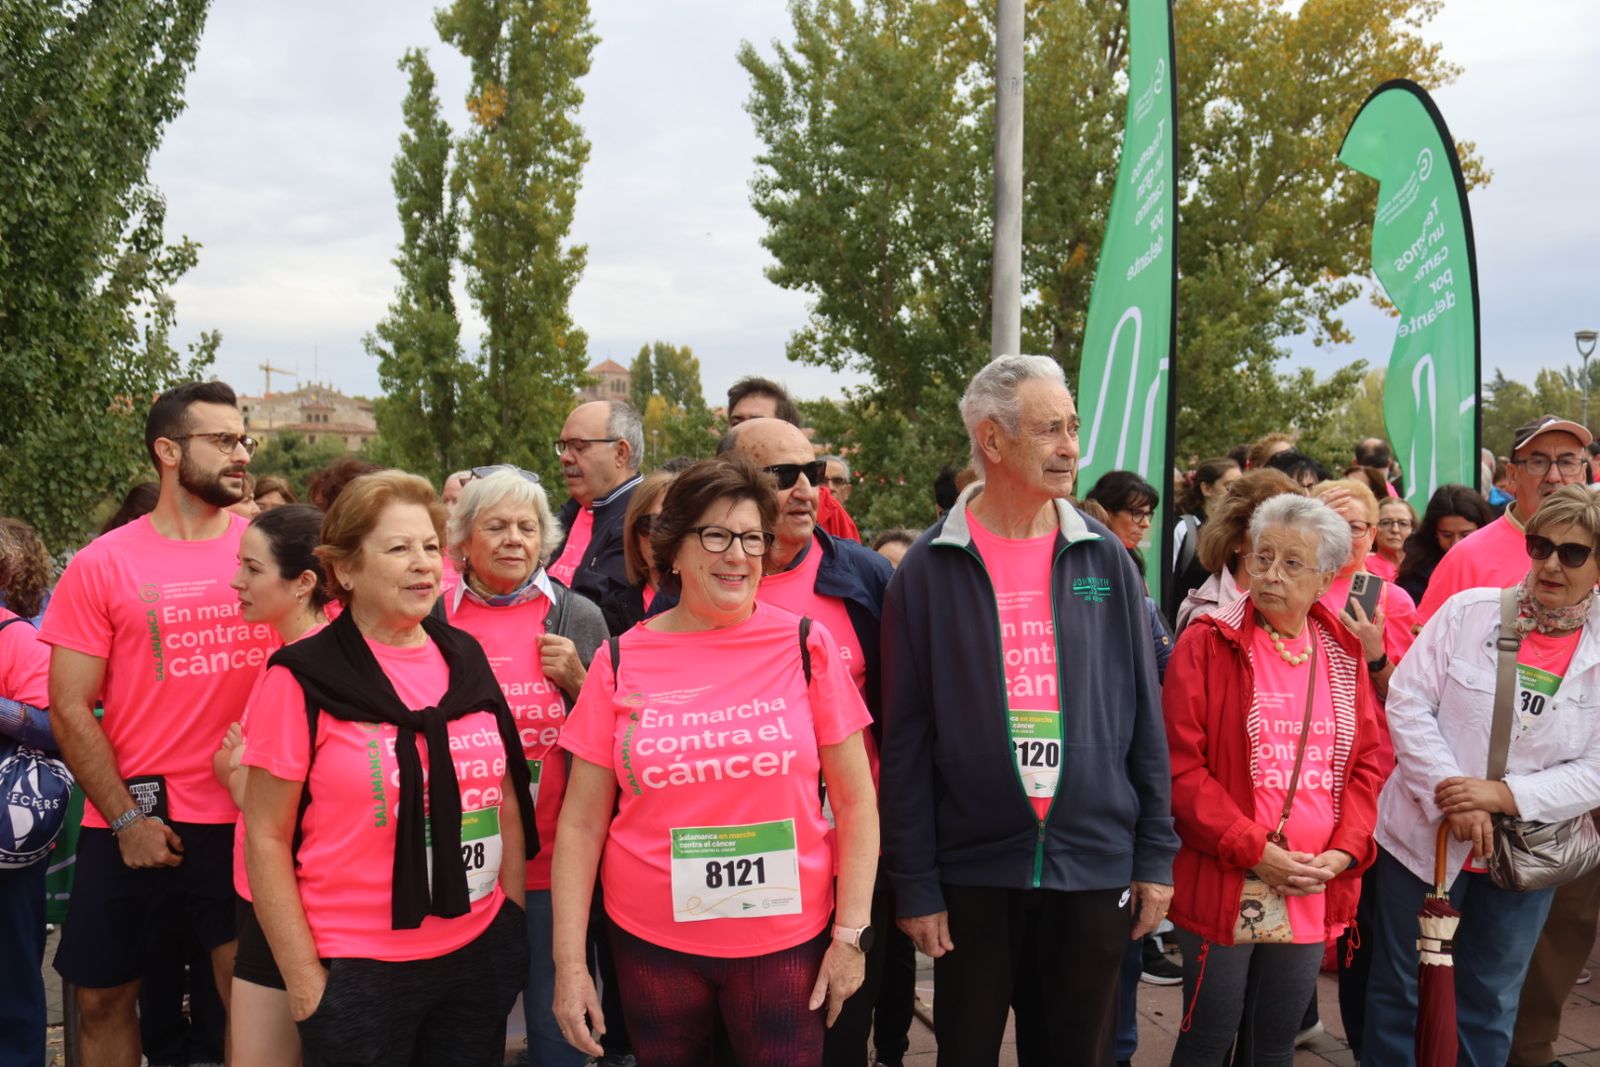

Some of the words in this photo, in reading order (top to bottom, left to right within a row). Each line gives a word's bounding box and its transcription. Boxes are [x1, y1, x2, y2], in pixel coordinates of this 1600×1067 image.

[162, 605, 192, 624] En
[197, 601, 242, 620] mar
[147, 609, 165, 681] SALAMANCA
[165, 623, 250, 650] contra
[1001, 622, 1017, 637] n
[641, 708, 674, 729] En
[682, 697, 787, 727] marcha
[635, 728, 753, 757] contra
[757, 717, 793, 742] el
[367, 739, 387, 828] SALAMANCA
[642, 749, 797, 790] cáncer
[6, 792, 60, 810] ECHERS
[705, 857, 766, 889] 8121
